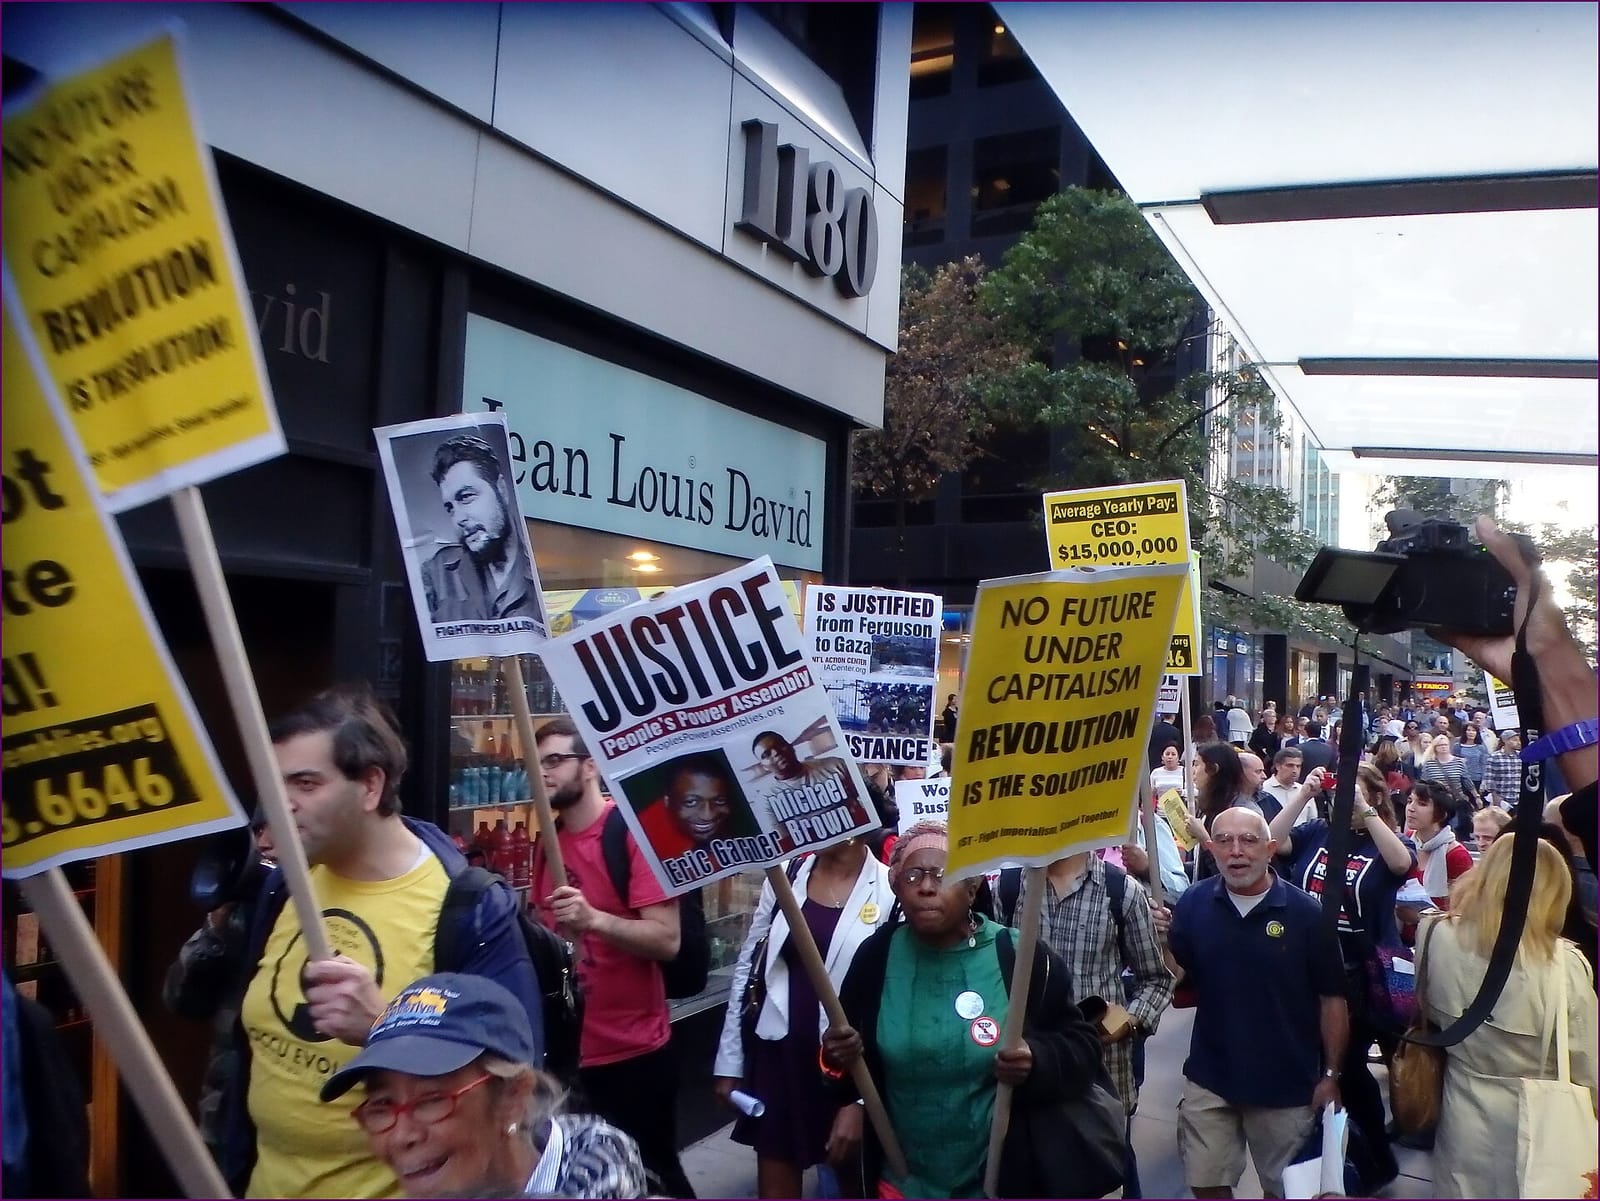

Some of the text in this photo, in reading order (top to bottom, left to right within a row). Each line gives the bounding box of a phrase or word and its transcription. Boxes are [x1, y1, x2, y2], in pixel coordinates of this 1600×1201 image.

[734, 118, 878, 298] 1180
[2, 448, 66, 524] ot
[607, 432, 714, 526] Louis
[724, 467, 812, 548] David
[1053, 496, 1175, 519] Average Yearly Pay:
[1058, 537, 1178, 561] $15,000,000
[1091, 520, 1137, 538] CEO:
[817, 592, 934, 618] IS JUSTIFIED
[1001, 591, 1157, 629] NO FUTURE
[815, 636, 872, 655] to Gaza
[816, 616, 853, 633] from
[859, 617, 932, 638] Ferguson
[1172, 638, 1188, 647] .org
[573, 571, 802, 733] JUSTICE
[1024, 632, 1123, 664] UNDER
[2, 652, 60, 716] d!
[987, 664, 1142, 704] CAPITALISM
[605, 668, 811, 757] People's Power Assembly
[968, 707, 1140, 763] REVOLUTION
[767, 772, 848, 823] Michael
[962, 757, 1128, 807] IS THE SOLUTION!
[784, 805, 856, 847] Brown
[912, 800, 949, 815] Busi
[662, 831, 782, 886] Eric Garner
